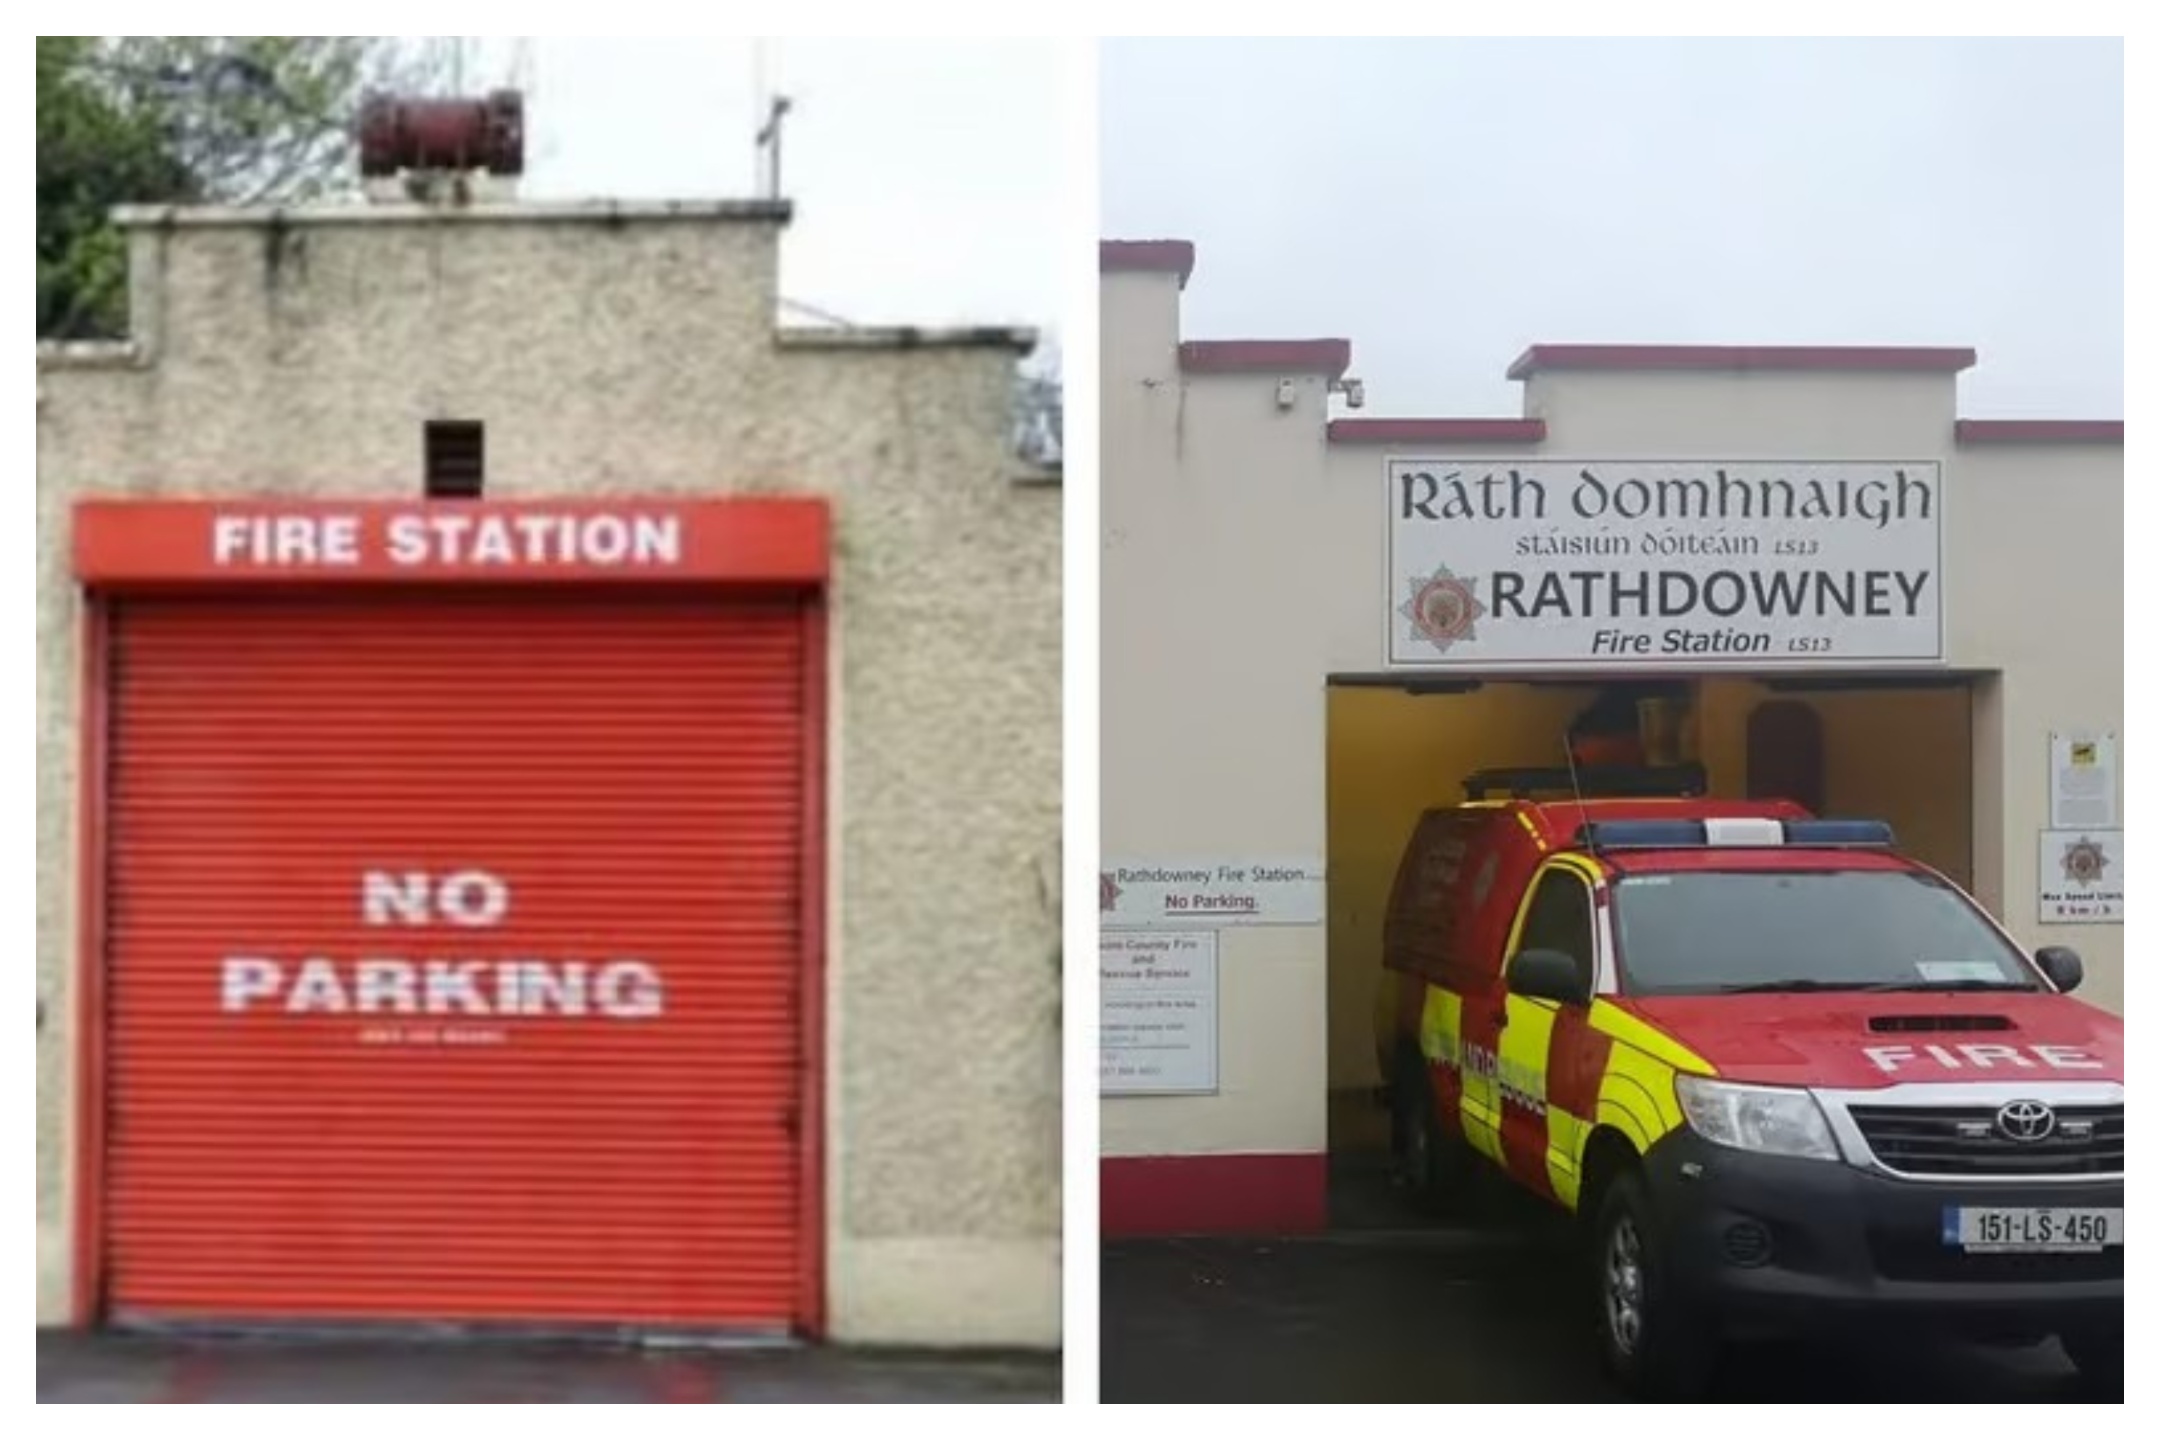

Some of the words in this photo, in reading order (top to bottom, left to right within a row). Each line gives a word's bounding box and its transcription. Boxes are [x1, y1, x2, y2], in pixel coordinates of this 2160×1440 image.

[1401, 470, 1546, 520] Ráth
[213, 515, 361, 565] FIRE
[386, 514, 682, 565] STATION
[1772, 540, 1820, 555] LS13
[1491, 569, 1931, 619] RATHDOWNEY
[1591, 629, 1651, 654] Fire
[1660, 627, 1771, 654] Station
[1788, 638, 1833, 652] LS13
[1118, 867, 1212, 885] Rathdowney
[1218, 866, 1246, 882] Fire
[1251, 866, 1305, 882] Station
[360, 868, 511, 928] NO
[1165, 894, 1188, 909] No
[220, 956, 664, 1018] PARKING
[1862, 1043, 2104, 1072] FIRE
[1978, 1214, 2108, 1243] 151-LS-450
